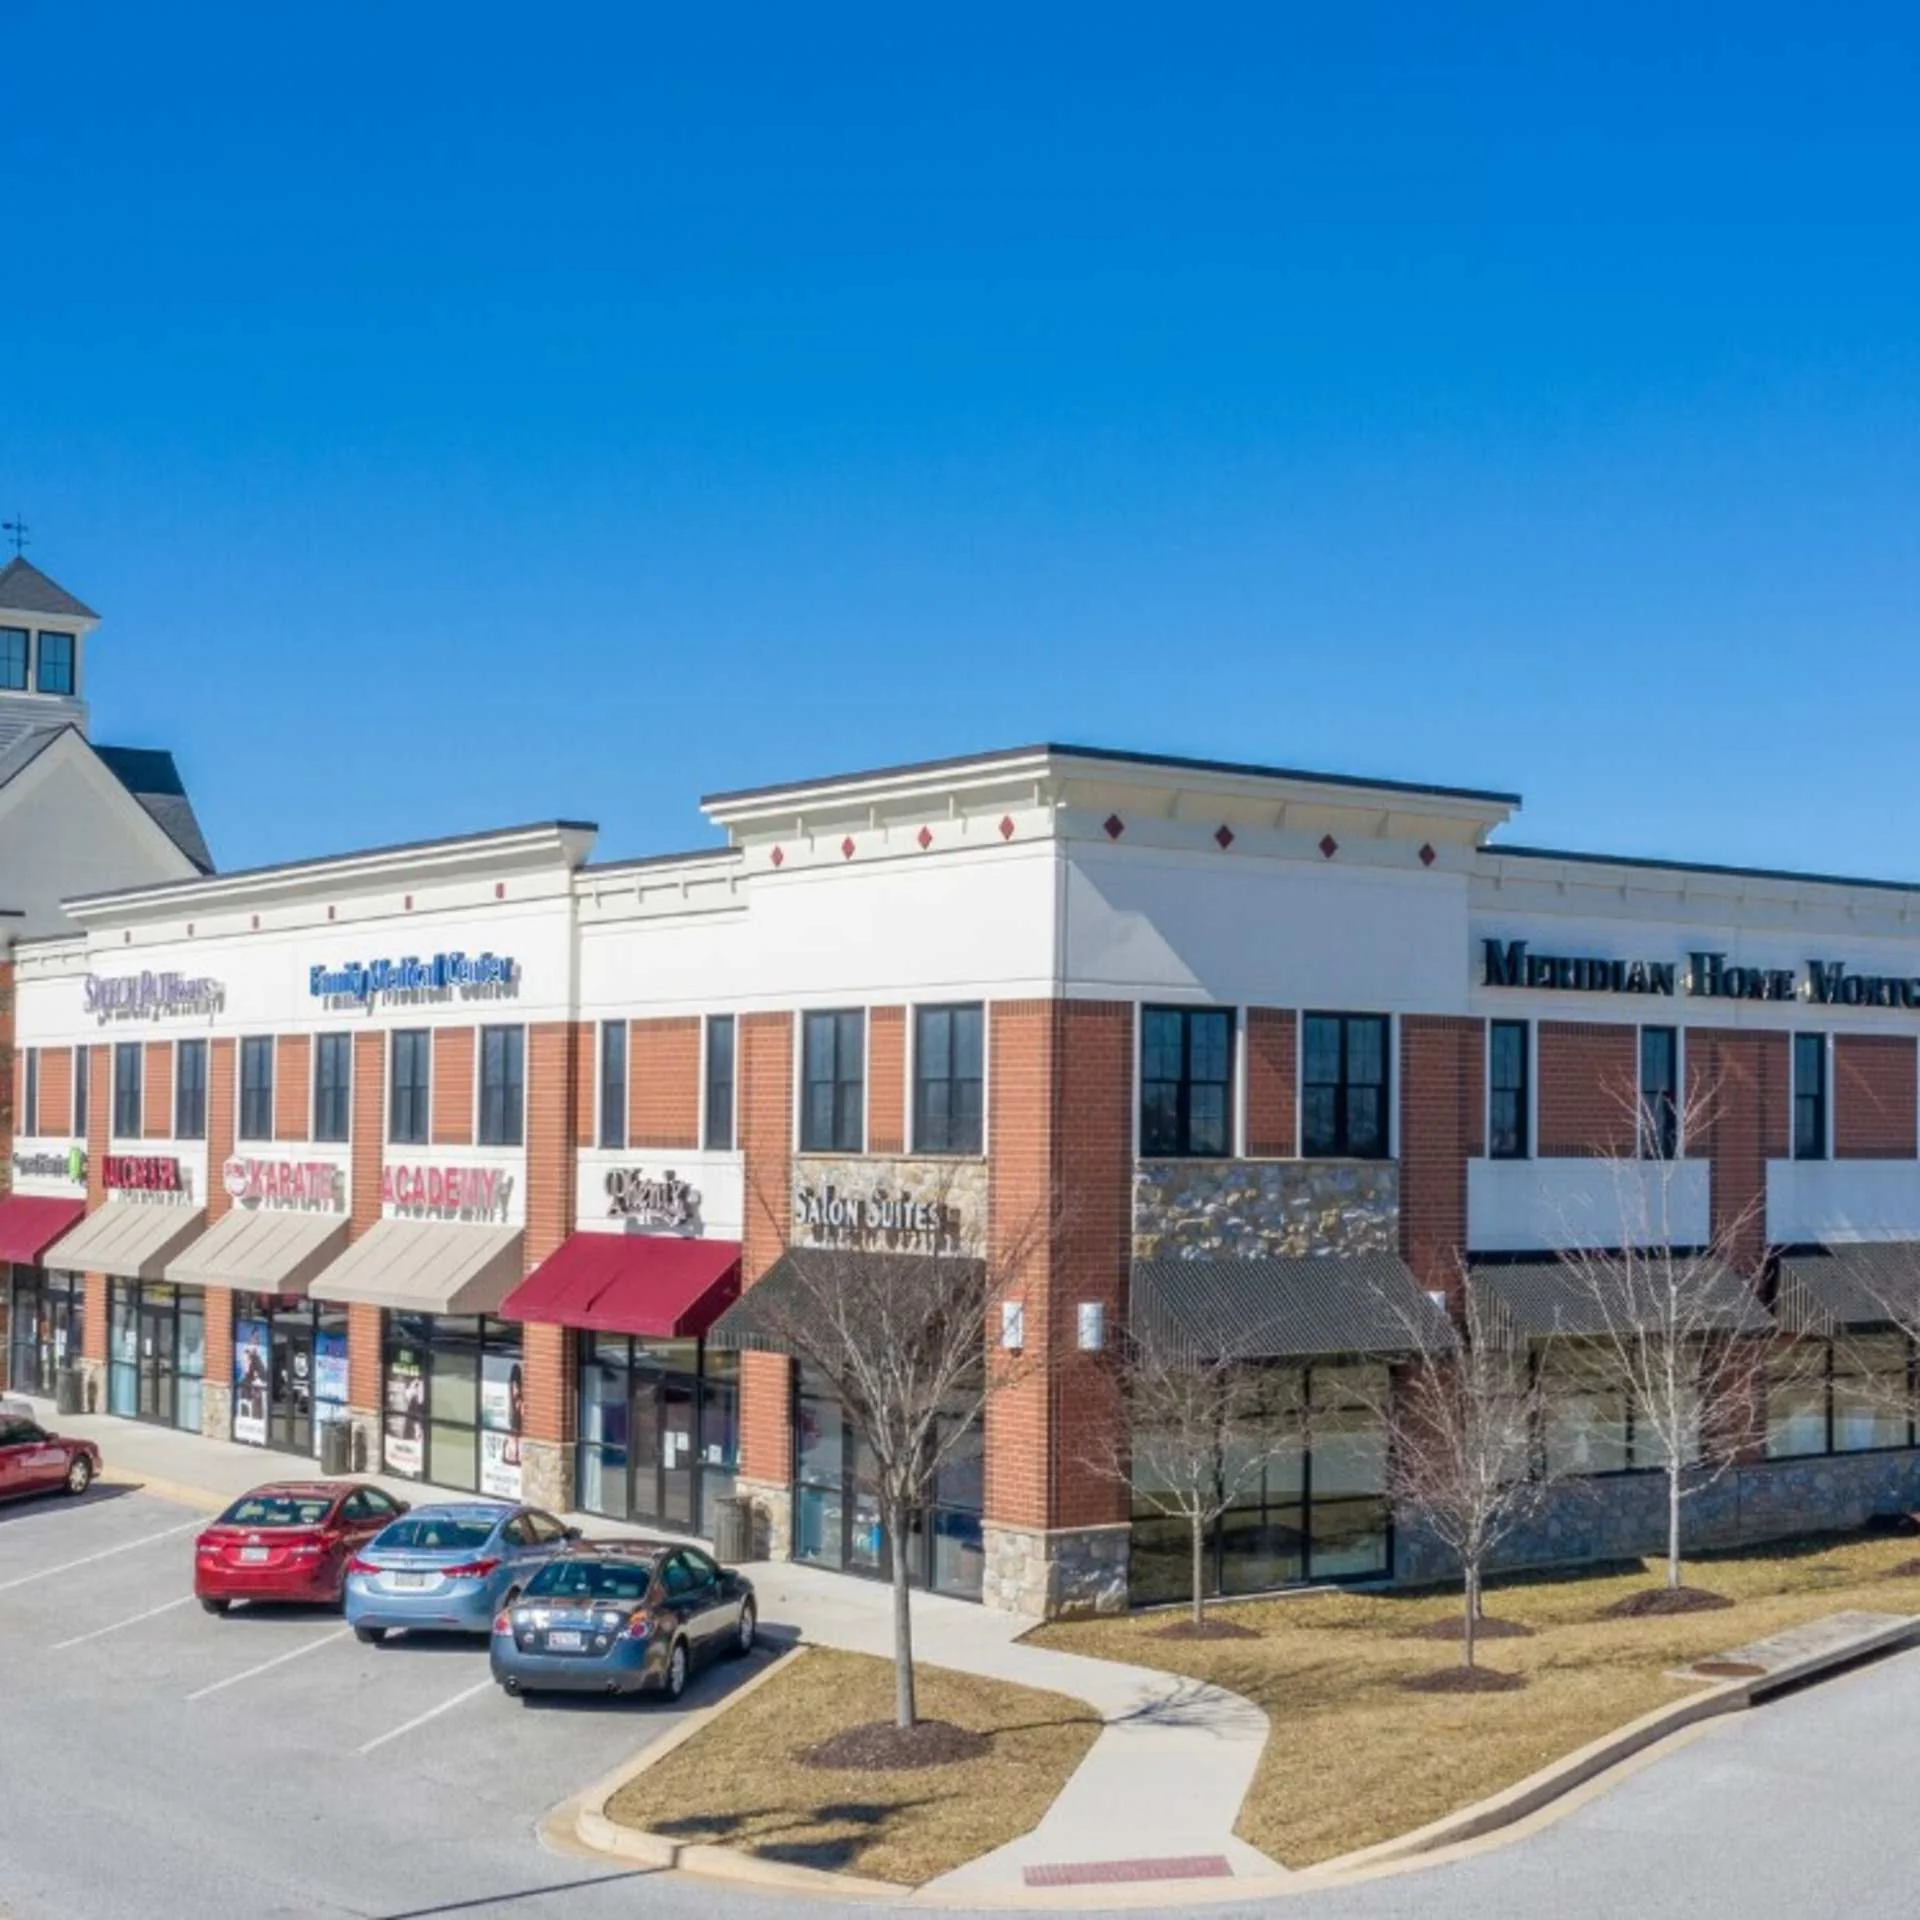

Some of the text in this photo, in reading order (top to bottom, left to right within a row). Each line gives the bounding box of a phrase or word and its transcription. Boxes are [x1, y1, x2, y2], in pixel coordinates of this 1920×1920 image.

[370, 953, 446, 993] Medical
[1481, 938, 1677, 997] MERIDIAN
[1686, 951, 1796, 1000] HOME
[248, 1159, 338, 1202] KARATE
[381, 1164, 502, 1208] ACADEMY
